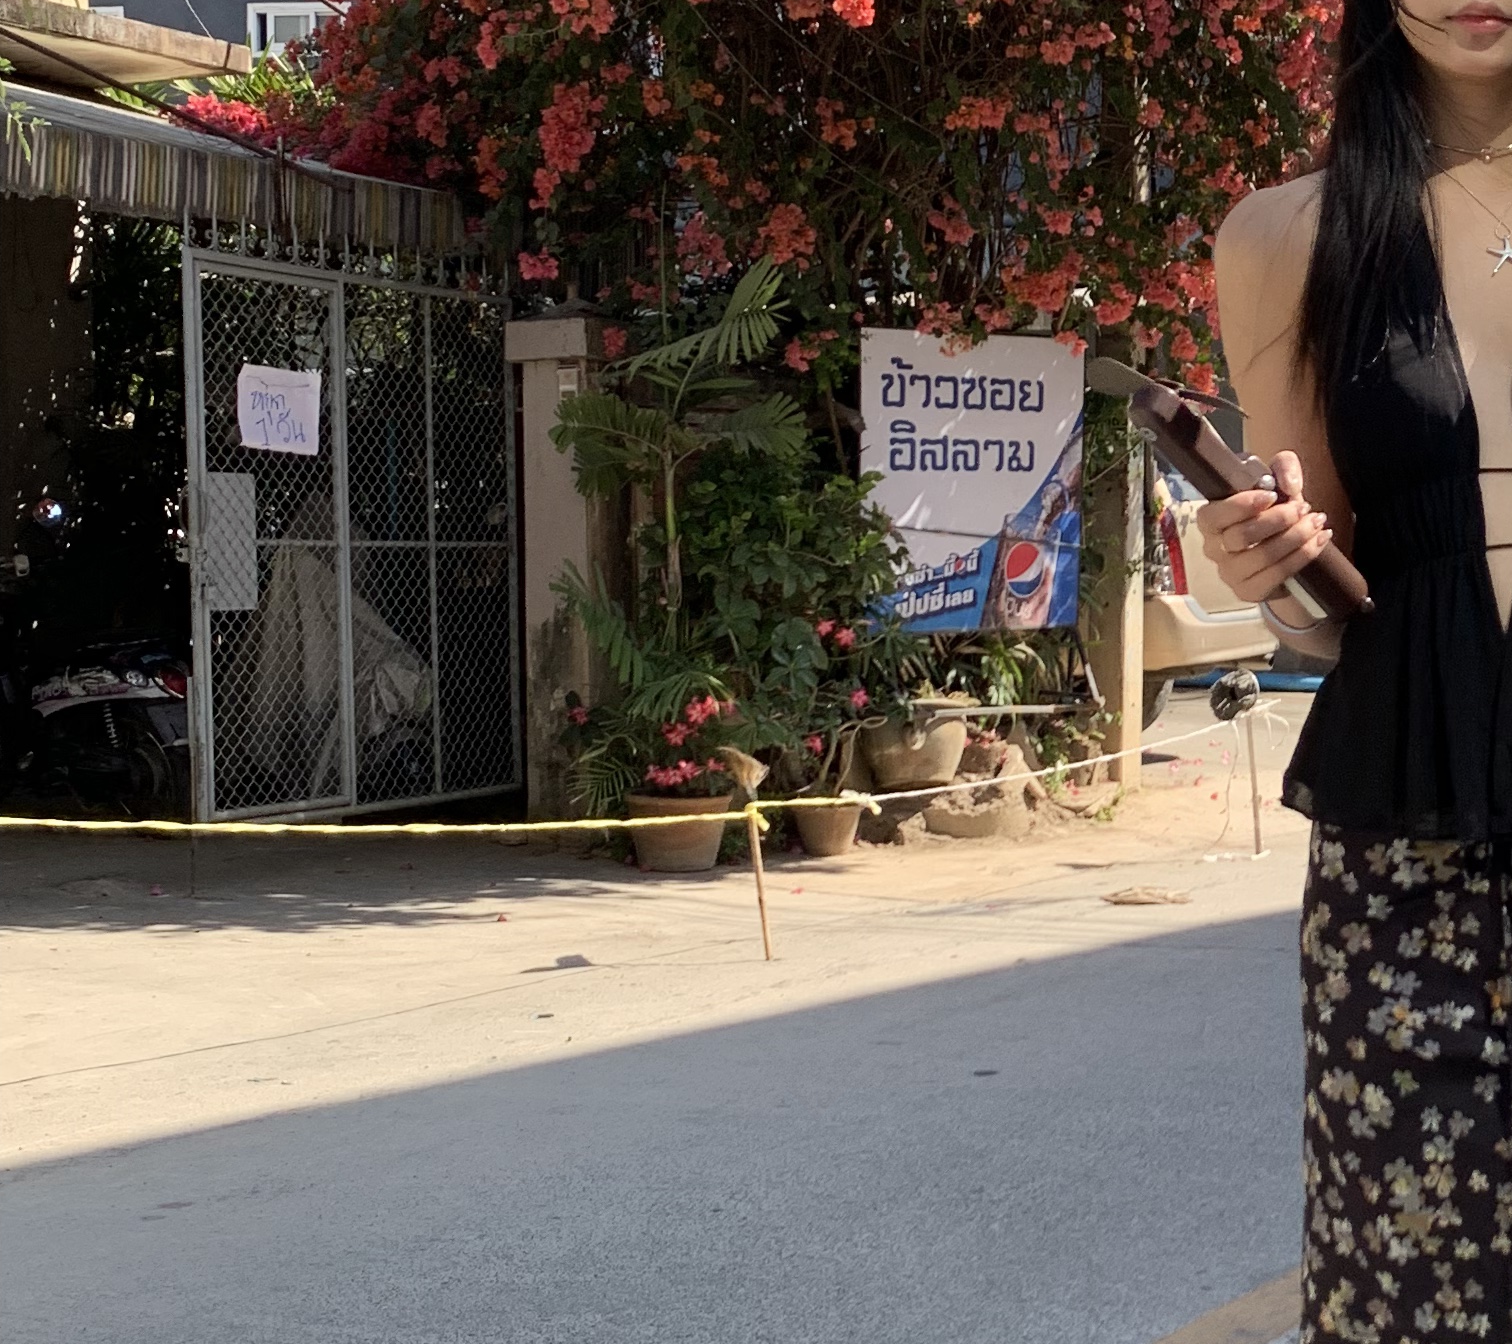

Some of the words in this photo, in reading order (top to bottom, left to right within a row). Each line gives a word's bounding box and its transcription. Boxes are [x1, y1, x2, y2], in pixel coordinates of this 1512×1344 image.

[881, 357, 1045, 413] ข้าวซอย
[889, 419, 1035, 473] อิสลาม
